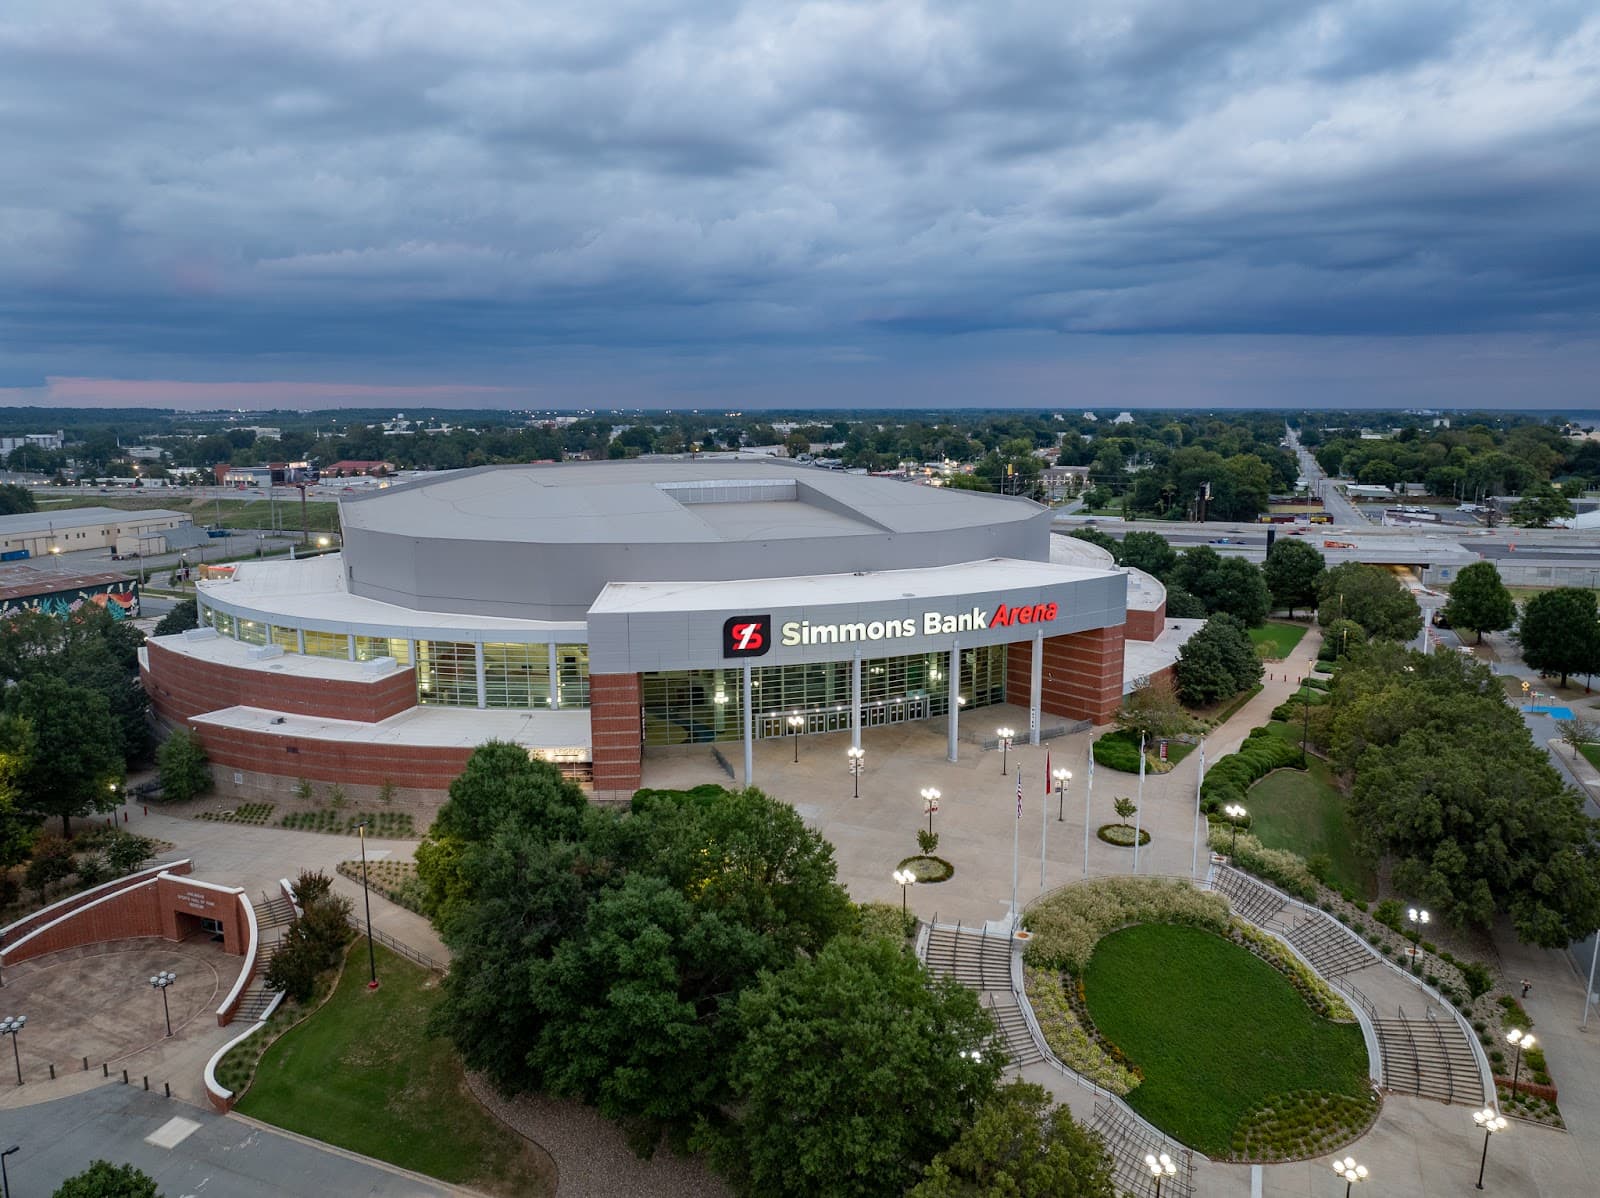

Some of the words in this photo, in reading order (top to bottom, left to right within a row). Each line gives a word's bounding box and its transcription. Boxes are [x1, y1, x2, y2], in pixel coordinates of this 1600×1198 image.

[782, 618, 916, 646] Simmons
[923, 607, 987, 635] Bank
[988, 602, 1058, 630] Arena
